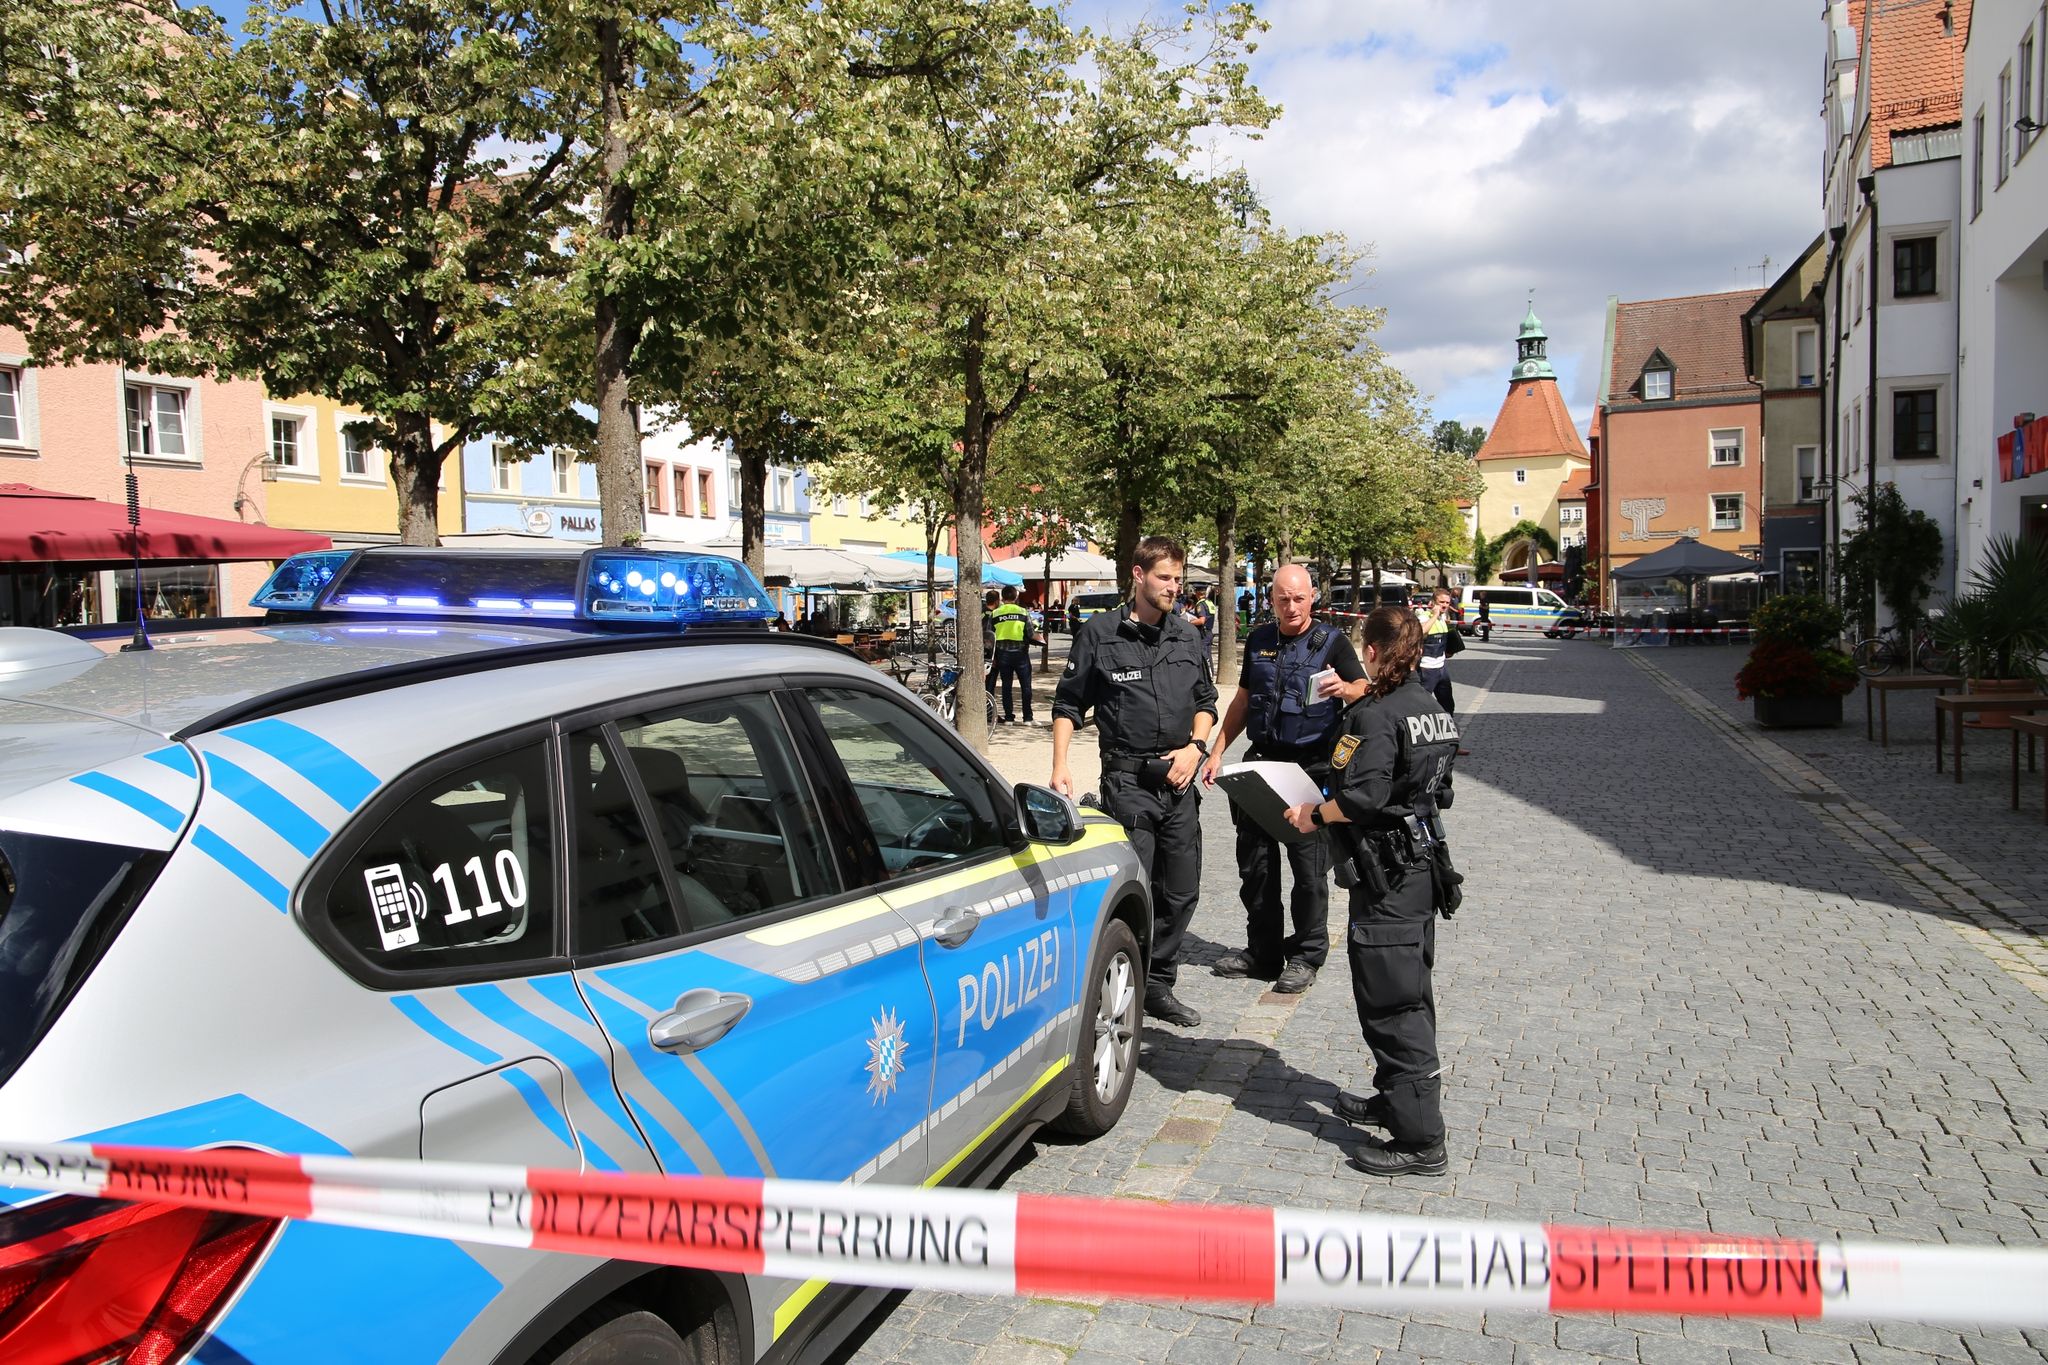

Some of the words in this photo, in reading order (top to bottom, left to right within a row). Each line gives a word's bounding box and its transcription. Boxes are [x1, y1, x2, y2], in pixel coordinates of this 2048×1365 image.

[561, 516, 596, 531] PALLAS
[1112, 670, 1142, 682] POLIZEI
[1406, 713, 1459, 745] POLIZE
[433, 849, 527, 925] 110
[957, 926, 1060, 1048] POLIZEI
[486, 1186, 991, 1268] POLIZEIABSPERRUNG
[1281, 1229, 1850, 1299] POLIZEIABSPERRUNG
